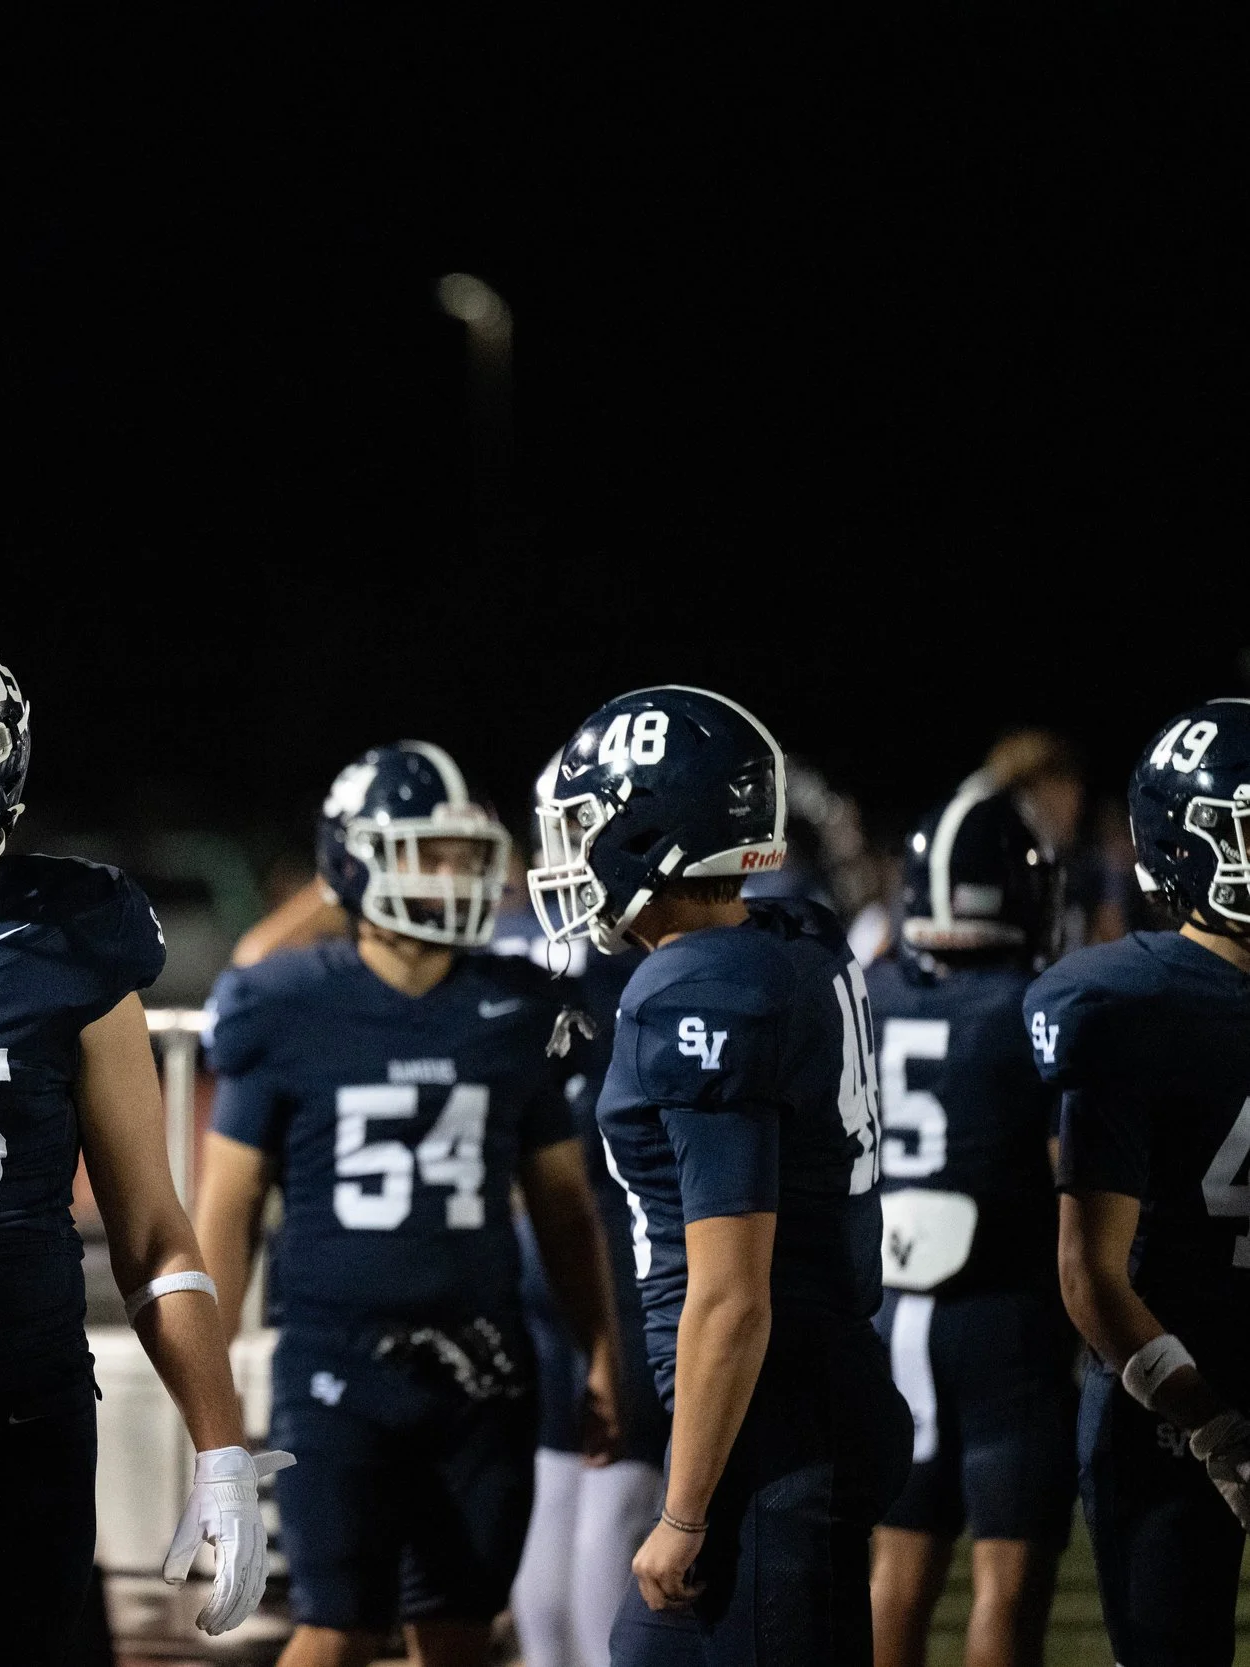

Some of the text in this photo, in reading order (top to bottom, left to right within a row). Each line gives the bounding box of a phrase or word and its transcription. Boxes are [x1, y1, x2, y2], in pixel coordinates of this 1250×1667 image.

[598, 711, 669, 766] 48
[1150, 719, 1218, 773] 49
[741, 850, 784, 869] Ridd
[678, 1017, 728, 1069] SV
[1032, 1011, 1059, 1063] SV
[334, 1083, 490, 1230] 54
